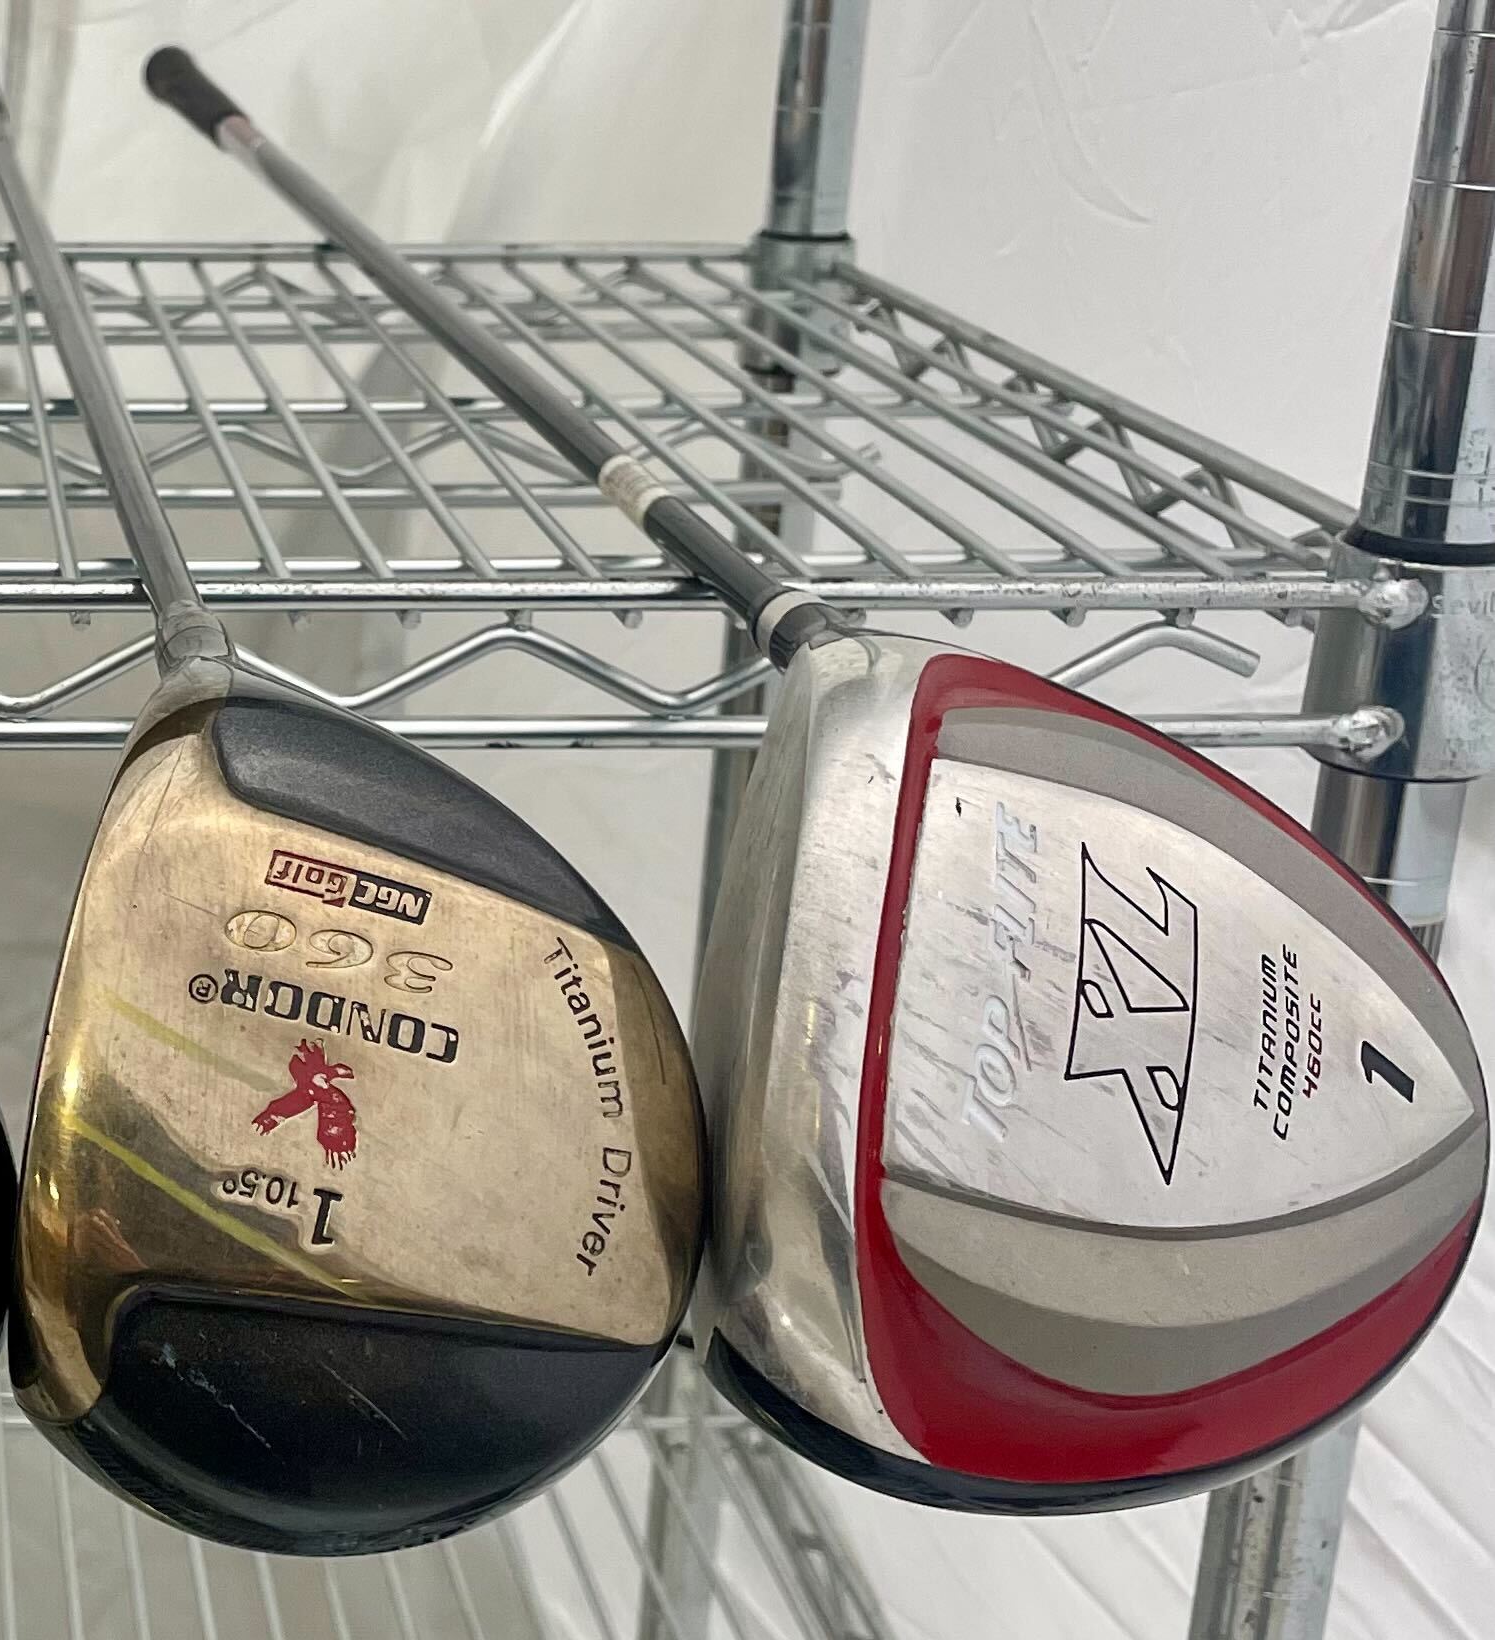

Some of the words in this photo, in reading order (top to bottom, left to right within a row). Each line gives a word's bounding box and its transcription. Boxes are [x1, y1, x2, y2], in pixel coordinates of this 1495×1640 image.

[273, 856, 348, 897] Golf
[355, 879, 425, 919] NGC
[223, 911, 454, 993] 360
[543, 936, 625, 1118] Titanium
[1253, 953, 1278, 1109] TITANIUM
[1273, 944, 1299, 1140] COMPOSITE
[1361, 1040, 1415, 1102] 1
[309, 1188, 344, 1246] 1
[575, 1147, 632, 1277] Driver
